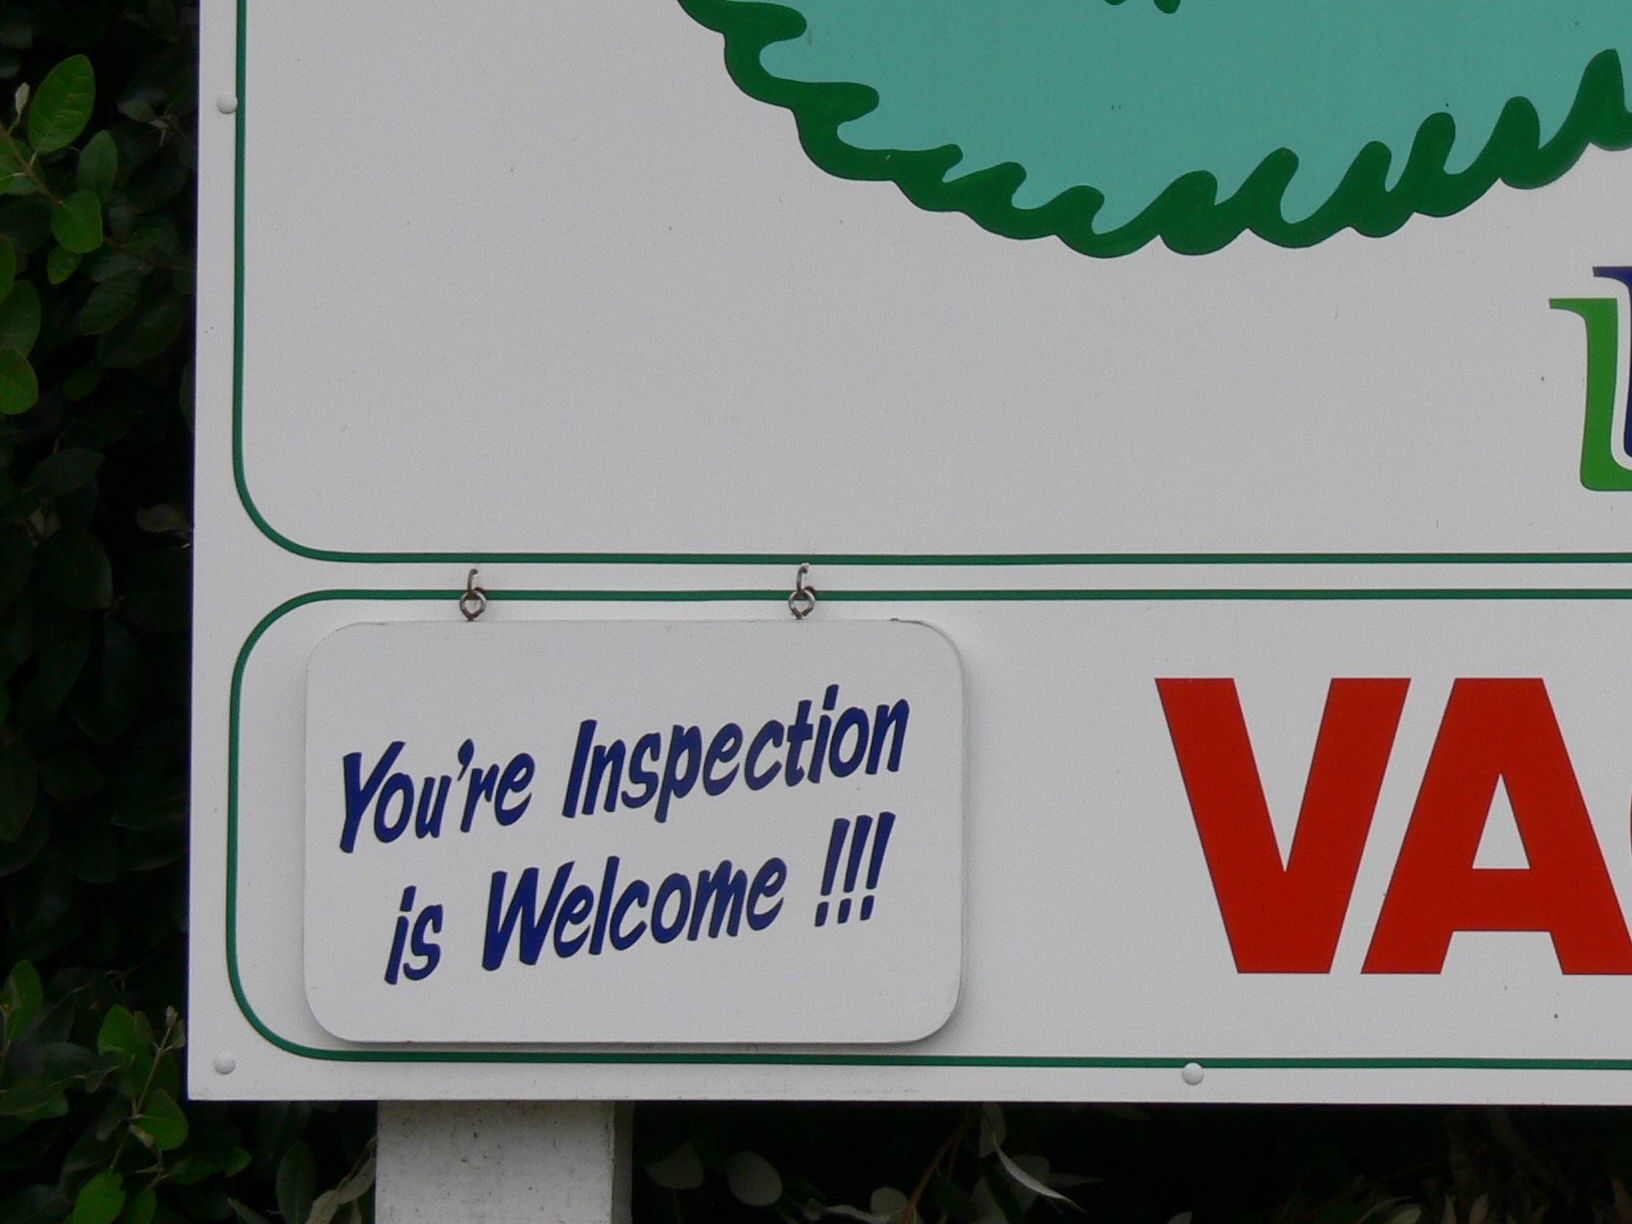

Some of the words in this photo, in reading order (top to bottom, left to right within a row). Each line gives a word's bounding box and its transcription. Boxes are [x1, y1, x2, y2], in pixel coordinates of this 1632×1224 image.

[341, 740, 535, 853] You're
[563, 685, 910, 823] Inspection
[385, 886, 443, 985] is
[483, 856, 787, 970] Welcome
[815, 812, 896, 926] !!!
